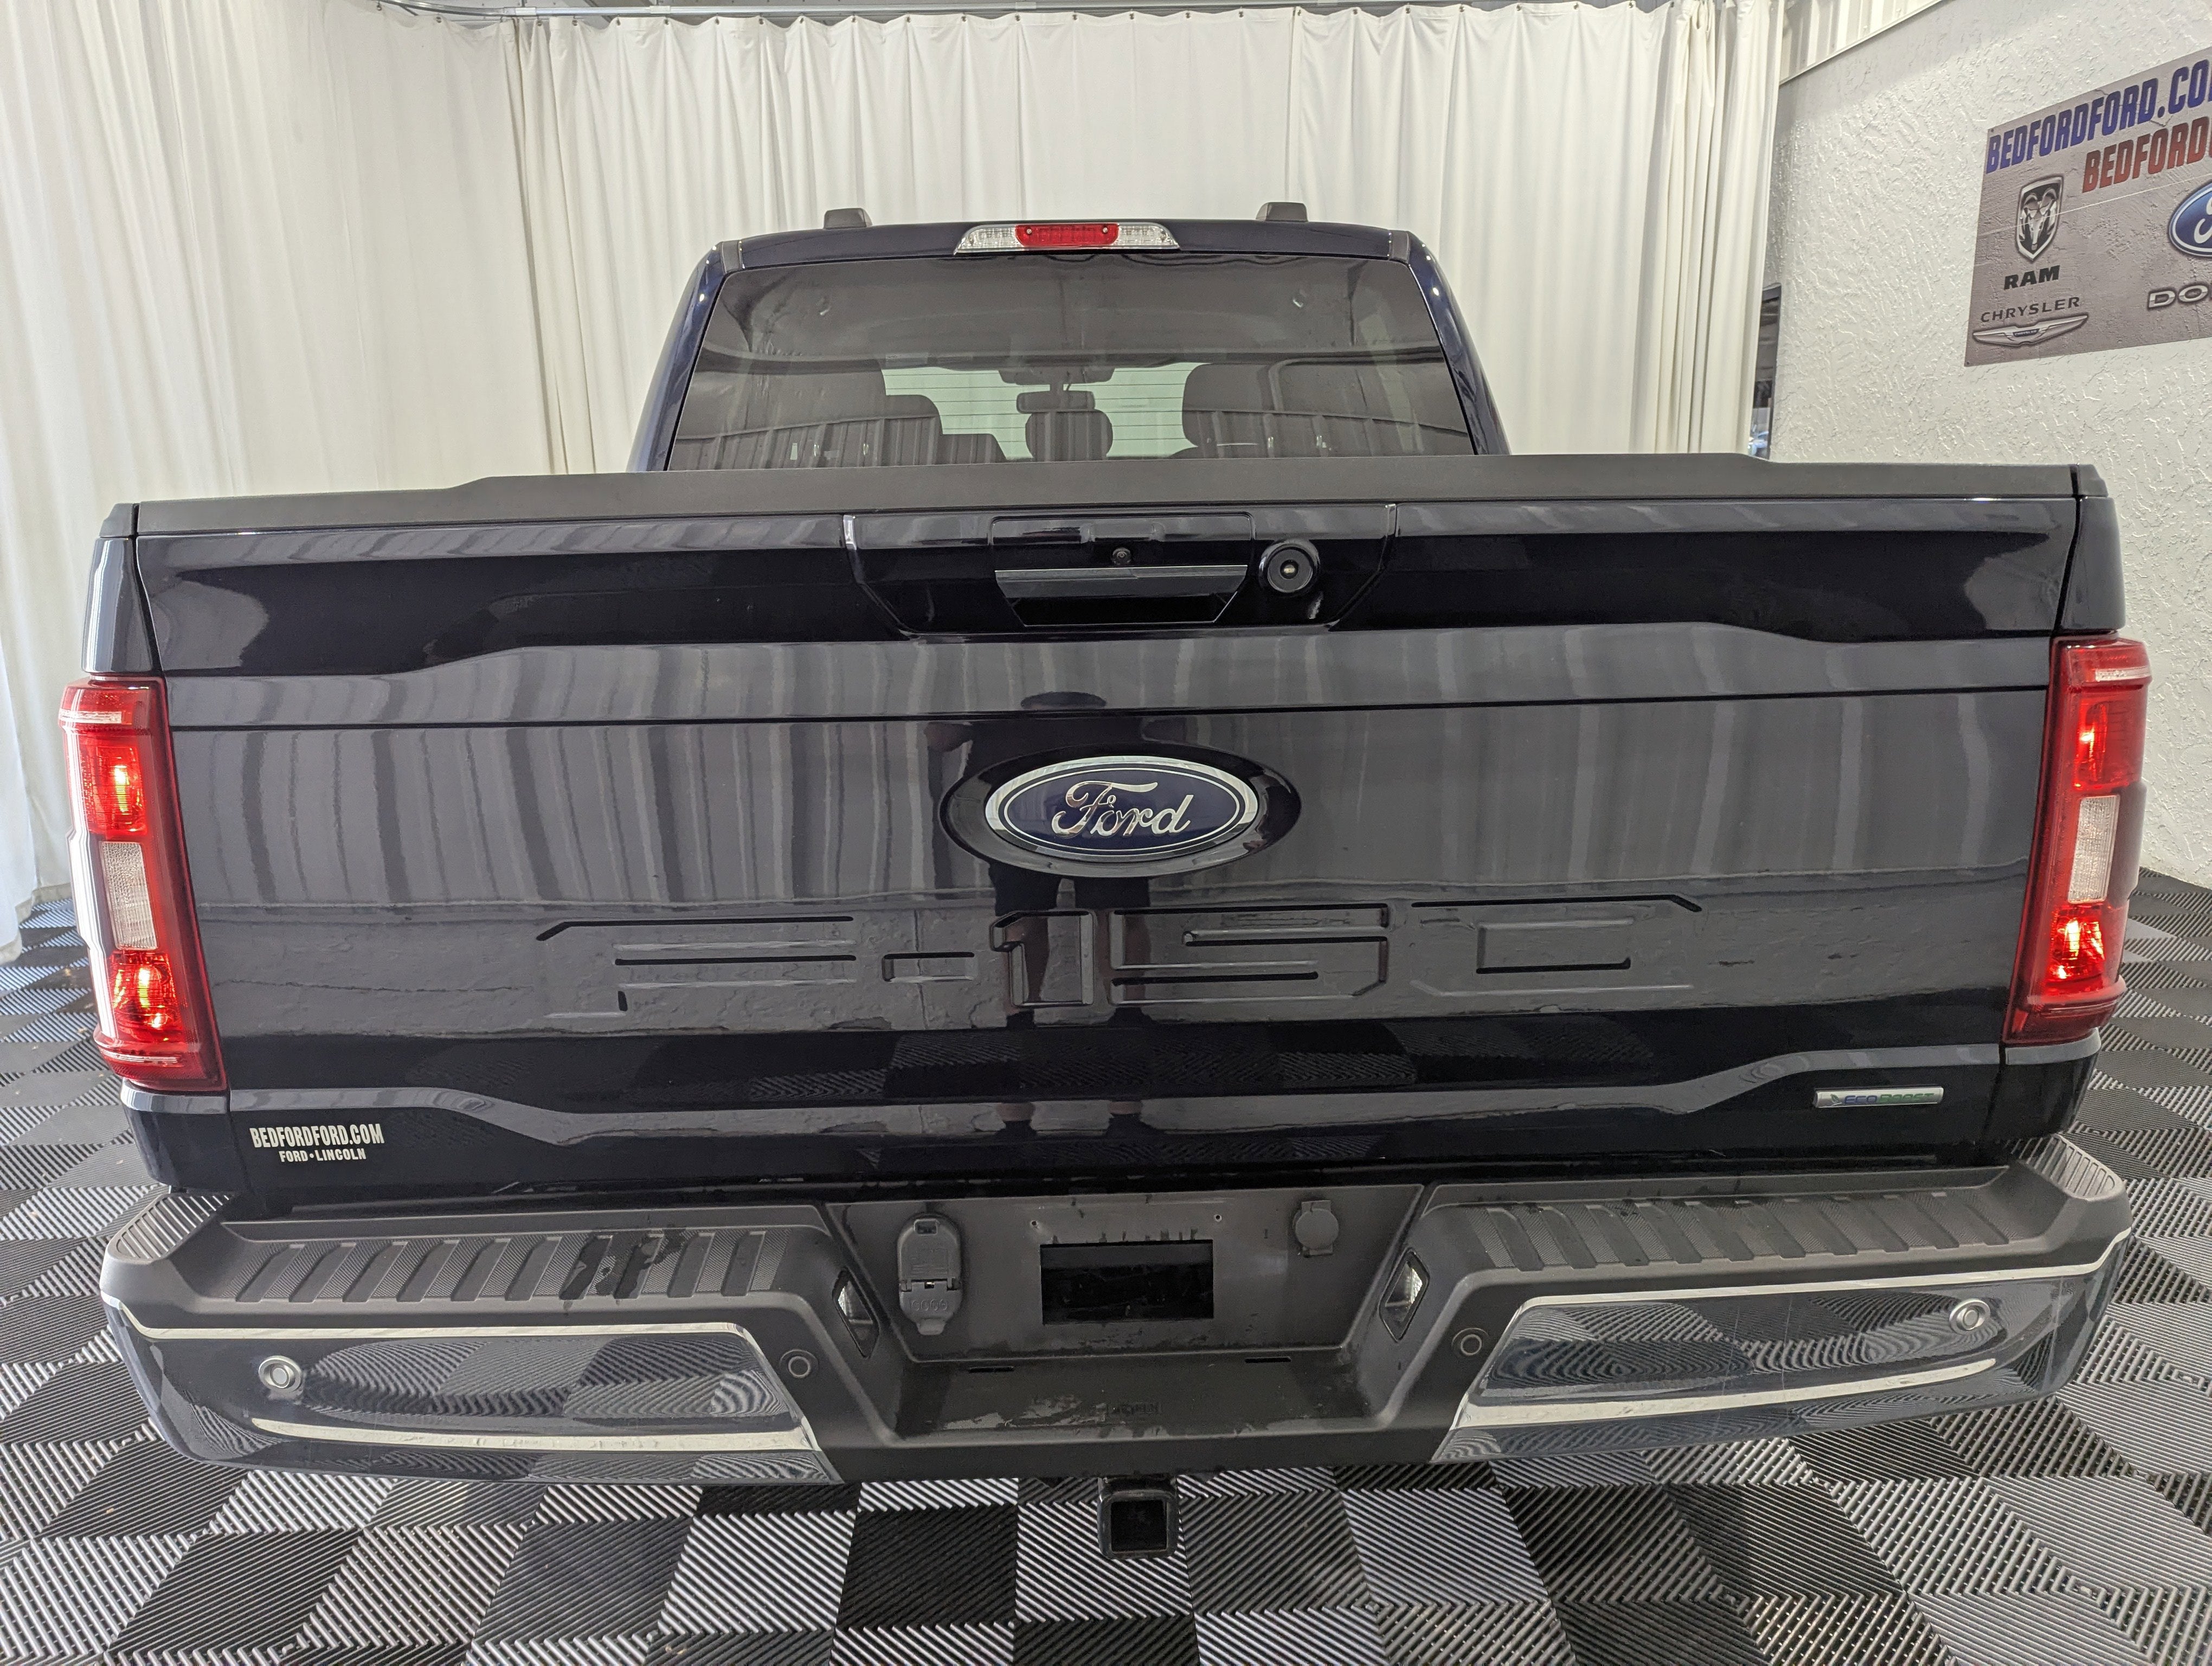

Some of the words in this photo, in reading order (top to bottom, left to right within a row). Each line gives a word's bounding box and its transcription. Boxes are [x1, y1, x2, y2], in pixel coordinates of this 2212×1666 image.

[1986, 59, 2212, 174] BEDFORDFORD.CO
[2082, 116, 2212, 193] BEDFORD
[2004, 265, 2060, 290] RAM
[2149, 285, 2212, 307] DO
[1981, 297, 2080, 322] CHRYSLER
[1051, 780, 1194, 838] Ford
[536, 894, 1702, 1020] F-150
[249, 1123, 384, 1148] BEDFORDFORD.COM
